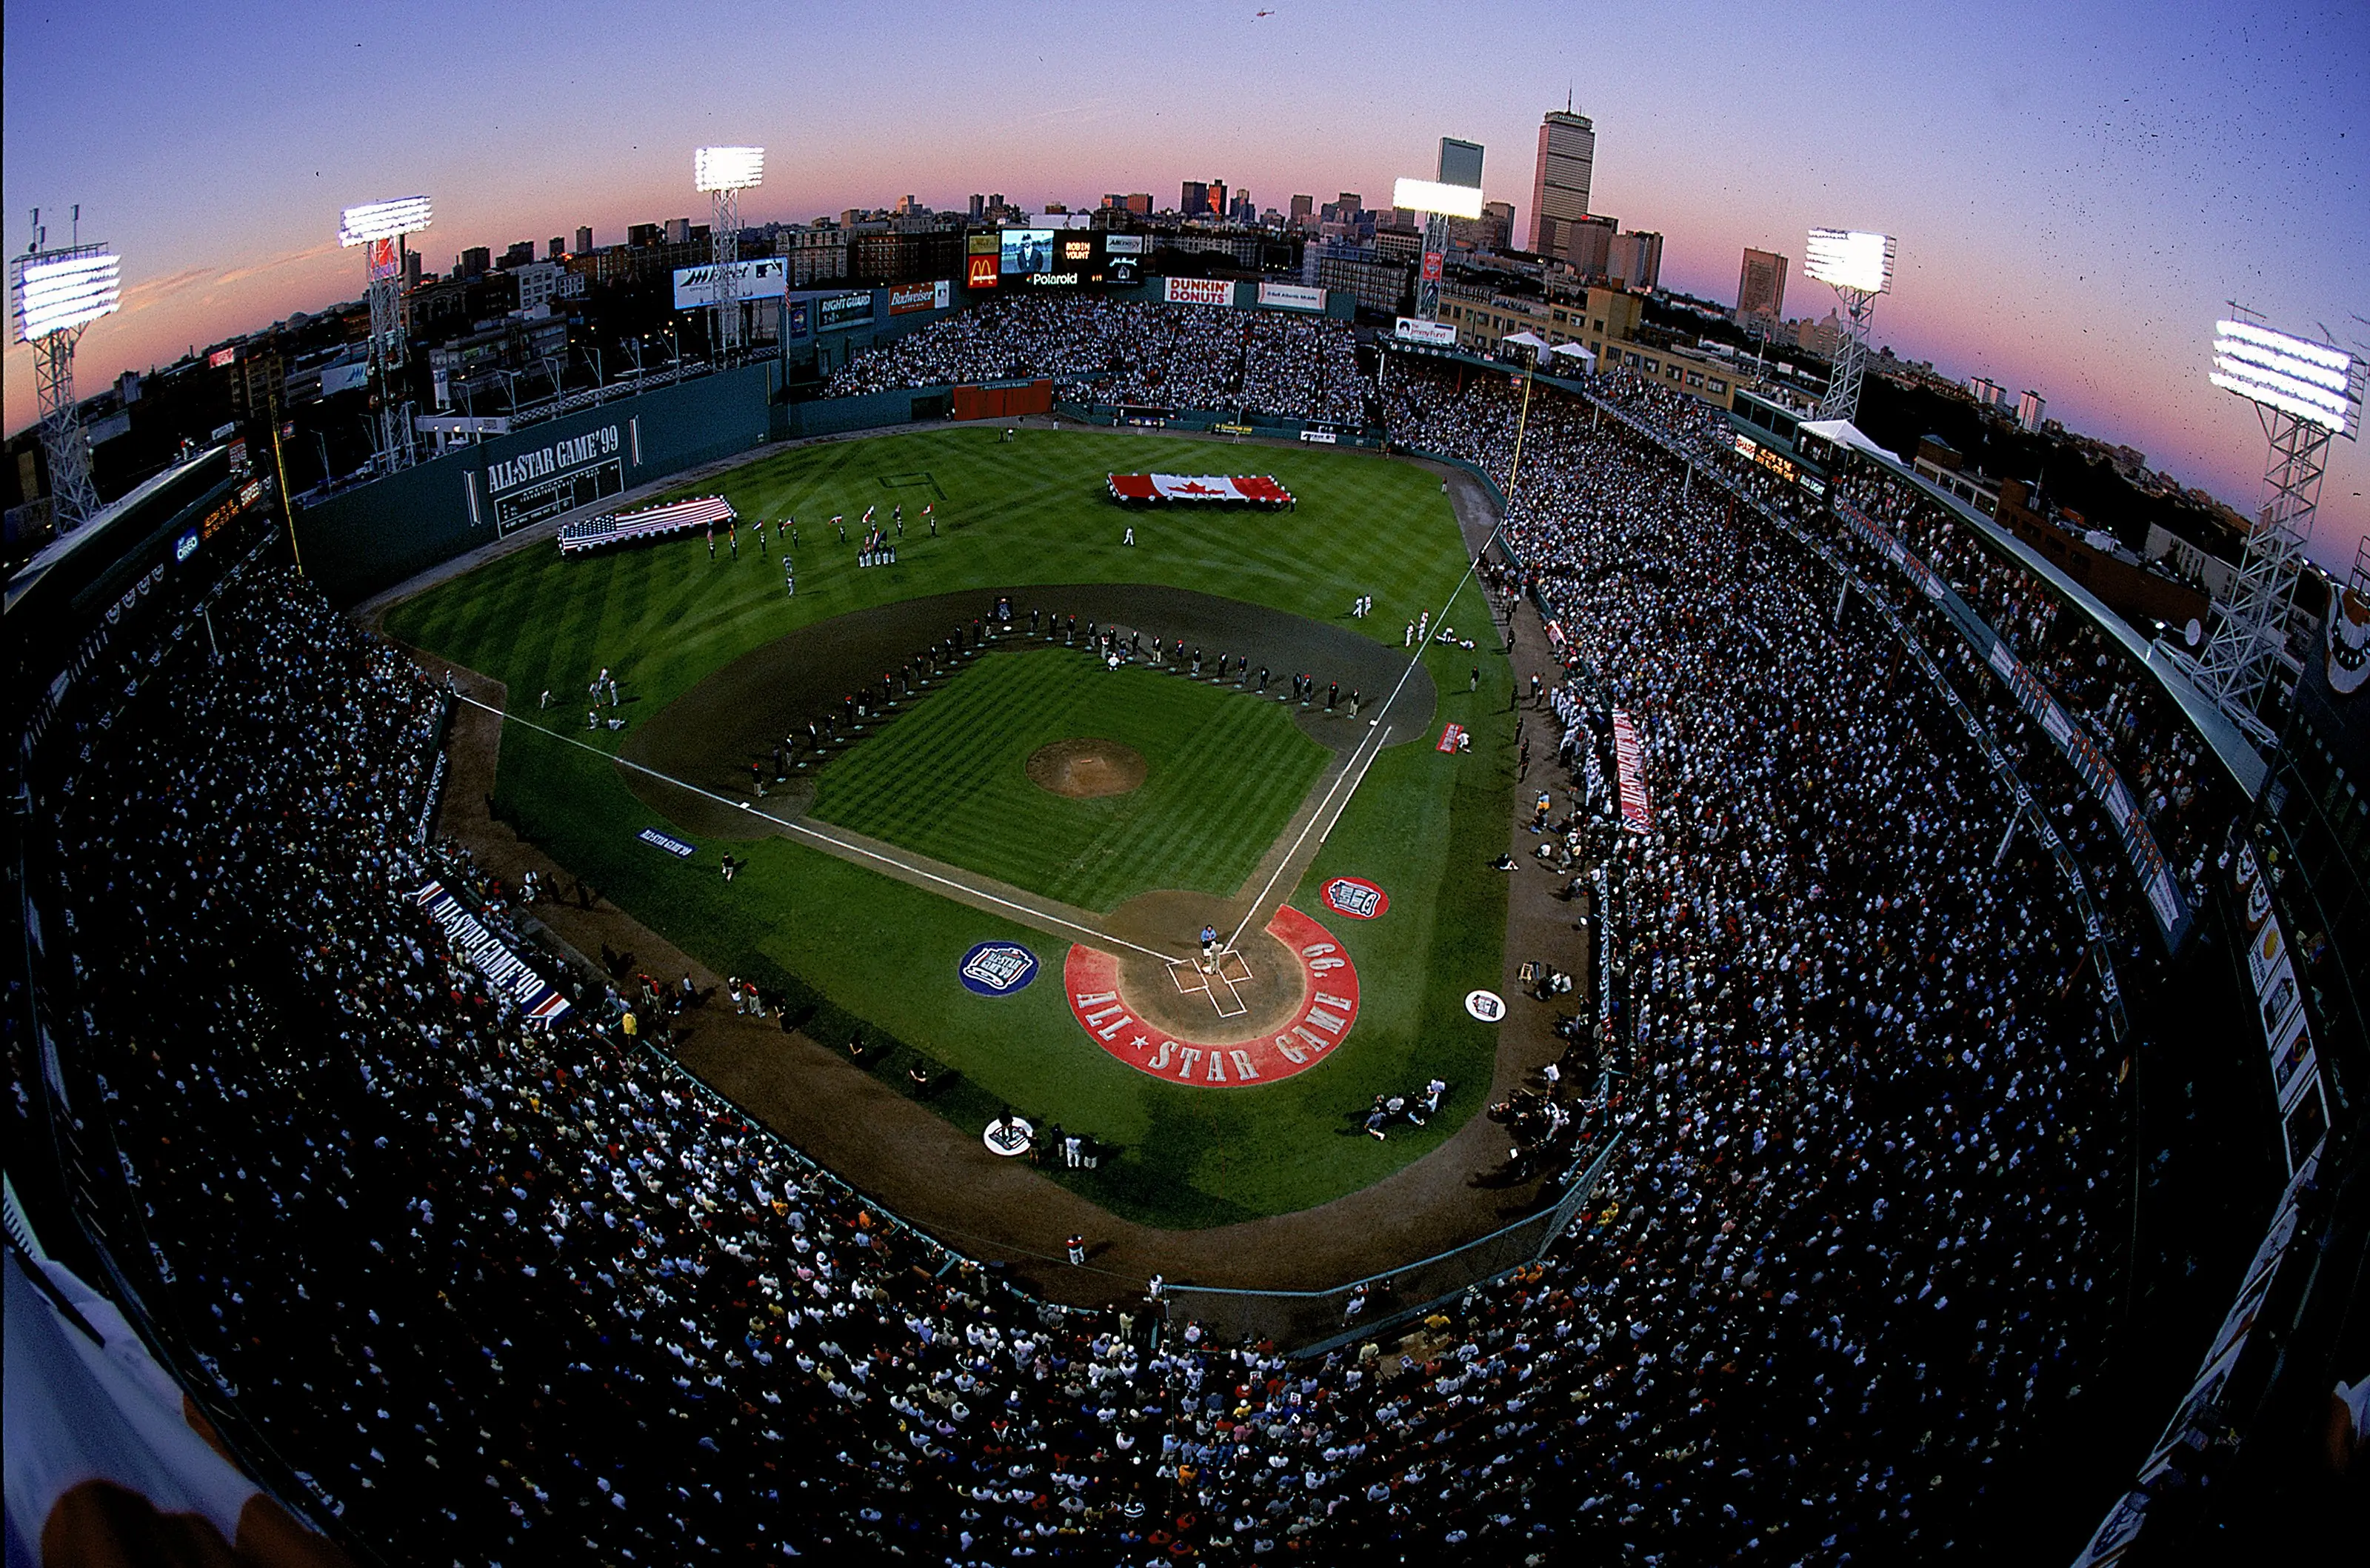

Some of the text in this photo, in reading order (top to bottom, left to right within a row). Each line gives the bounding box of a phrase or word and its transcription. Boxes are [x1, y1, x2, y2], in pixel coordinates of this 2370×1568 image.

[1066, 242, 1090, 251] ROBIN
[1066, 251, 1090, 259] YOUNT
[1034, 273, 1078, 285] Polaroid
[1170, 279, 1229, 293] DUNKIN'
[822, 295, 870, 313] RIGHT GUARD
[891, 290, 934, 307] Budweiser
[1169, 290, 1225, 304] DONUTS
[1410, 329, 1429, 337] Jimmy
[1430, 330, 1446, 339] Fund
[517, 447, 555, 482] STAR
[556, 433, 597, 468] GAME
[595, 424, 619, 454] '99
[1735, 438, 1755, 455] SHARP
[523, 479, 564, 496] AMERICAN
[177, 536, 197, 561] OREO
[473, 938, 526, 987] GAME
[515, 967, 546, 1004] '99
[1076, 942, 1352, 1082] ALL STAR GAME '99
